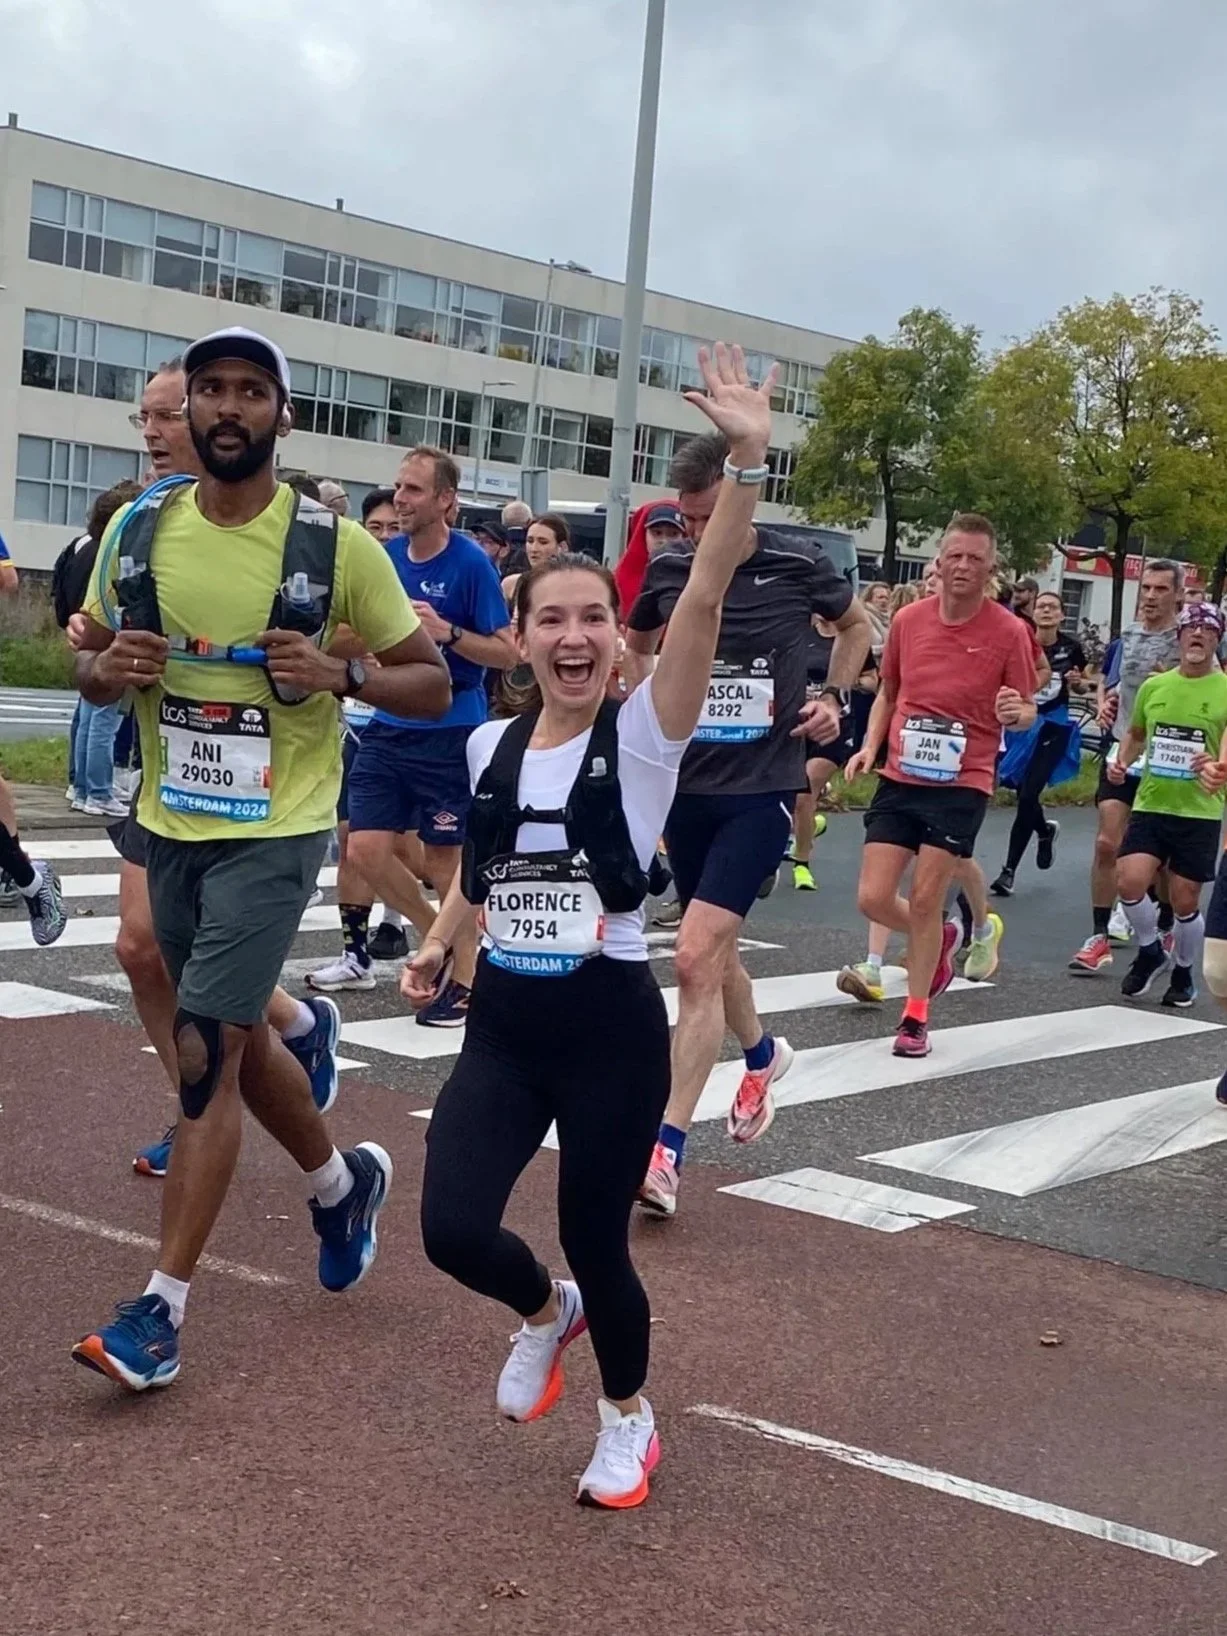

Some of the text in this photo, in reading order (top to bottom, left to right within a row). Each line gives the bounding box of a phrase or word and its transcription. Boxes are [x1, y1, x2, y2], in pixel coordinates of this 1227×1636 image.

[707, 685, 753, 700] ASCAL
[708, 703, 742, 717] 8292
[239, 723, 264, 733] TATA
[918, 738, 941, 750] JAN
[191, 741, 222, 763] ANI
[915, 750, 941, 762] 8704
[1161, 753, 1186, 764] 17401
[181, 763, 233, 787] 29030
[161, 791, 267, 817] AMSTERDAM 2024
[488, 893, 582, 912] FLORENCE
[511, 919, 558, 939] 7954
